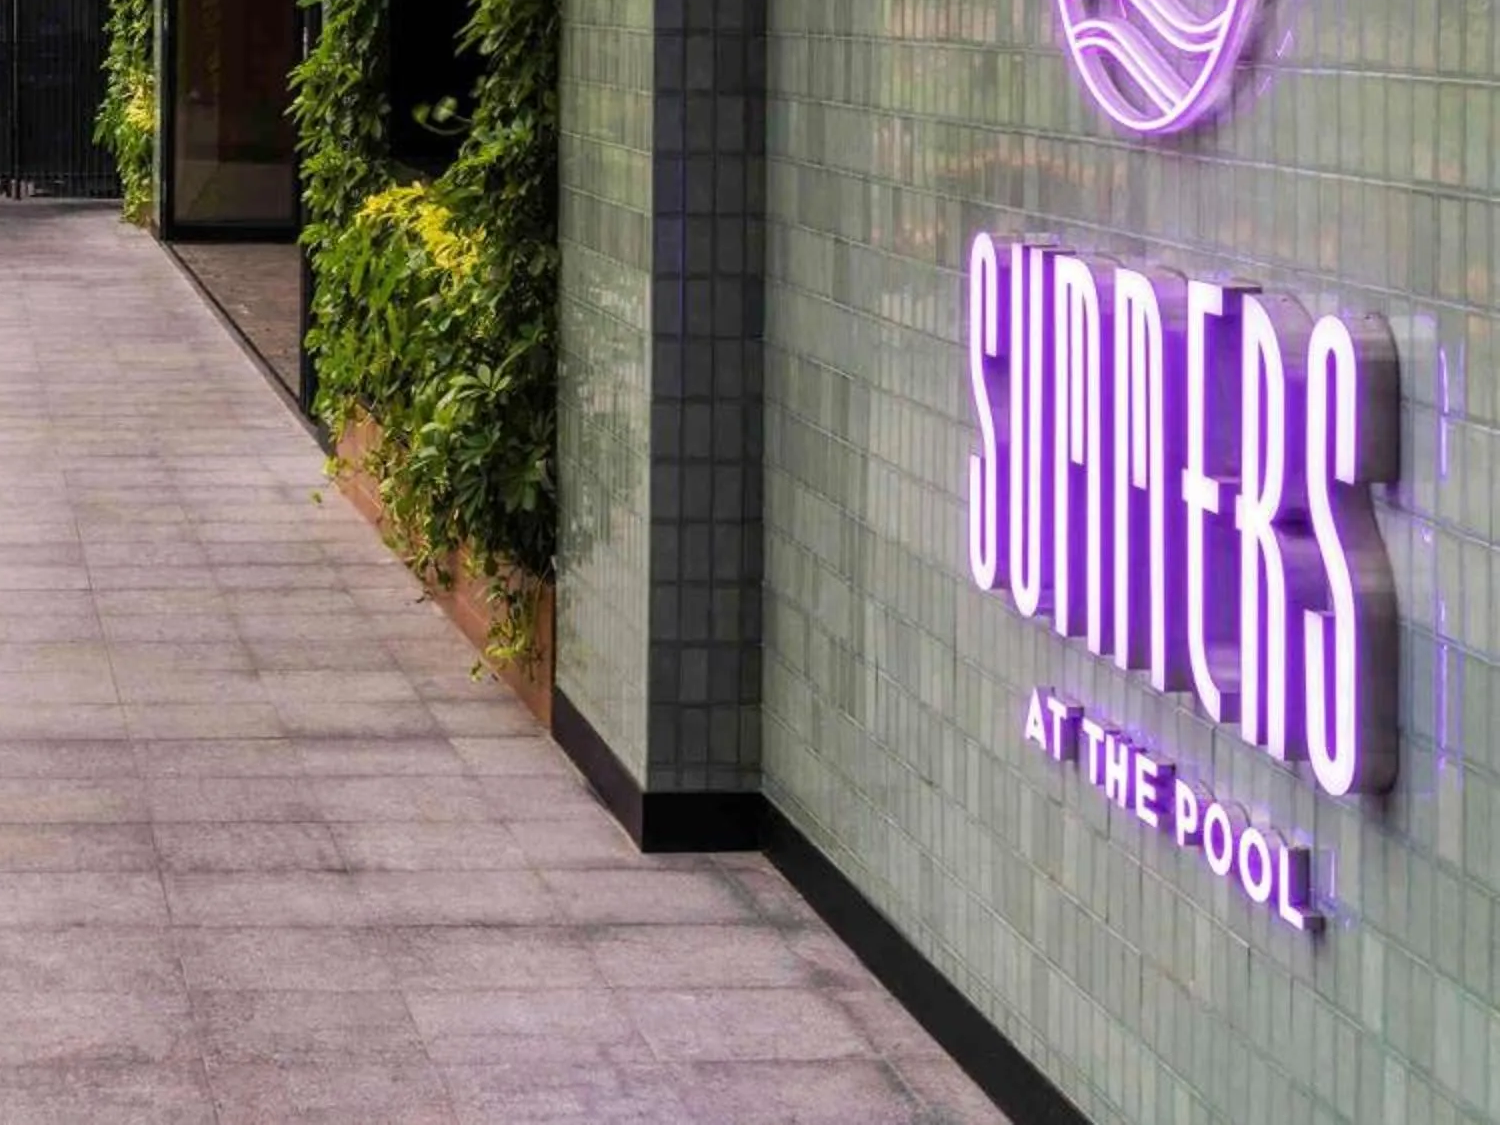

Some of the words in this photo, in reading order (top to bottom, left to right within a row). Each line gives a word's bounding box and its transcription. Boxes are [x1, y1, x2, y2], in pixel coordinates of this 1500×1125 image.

[969, 232, 1357, 795] SUMMERS
[1025, 687, 1069, 761] AT
[1081, 717, 1159, 828] THE
[1176, 779, 1305, 931] POOL
